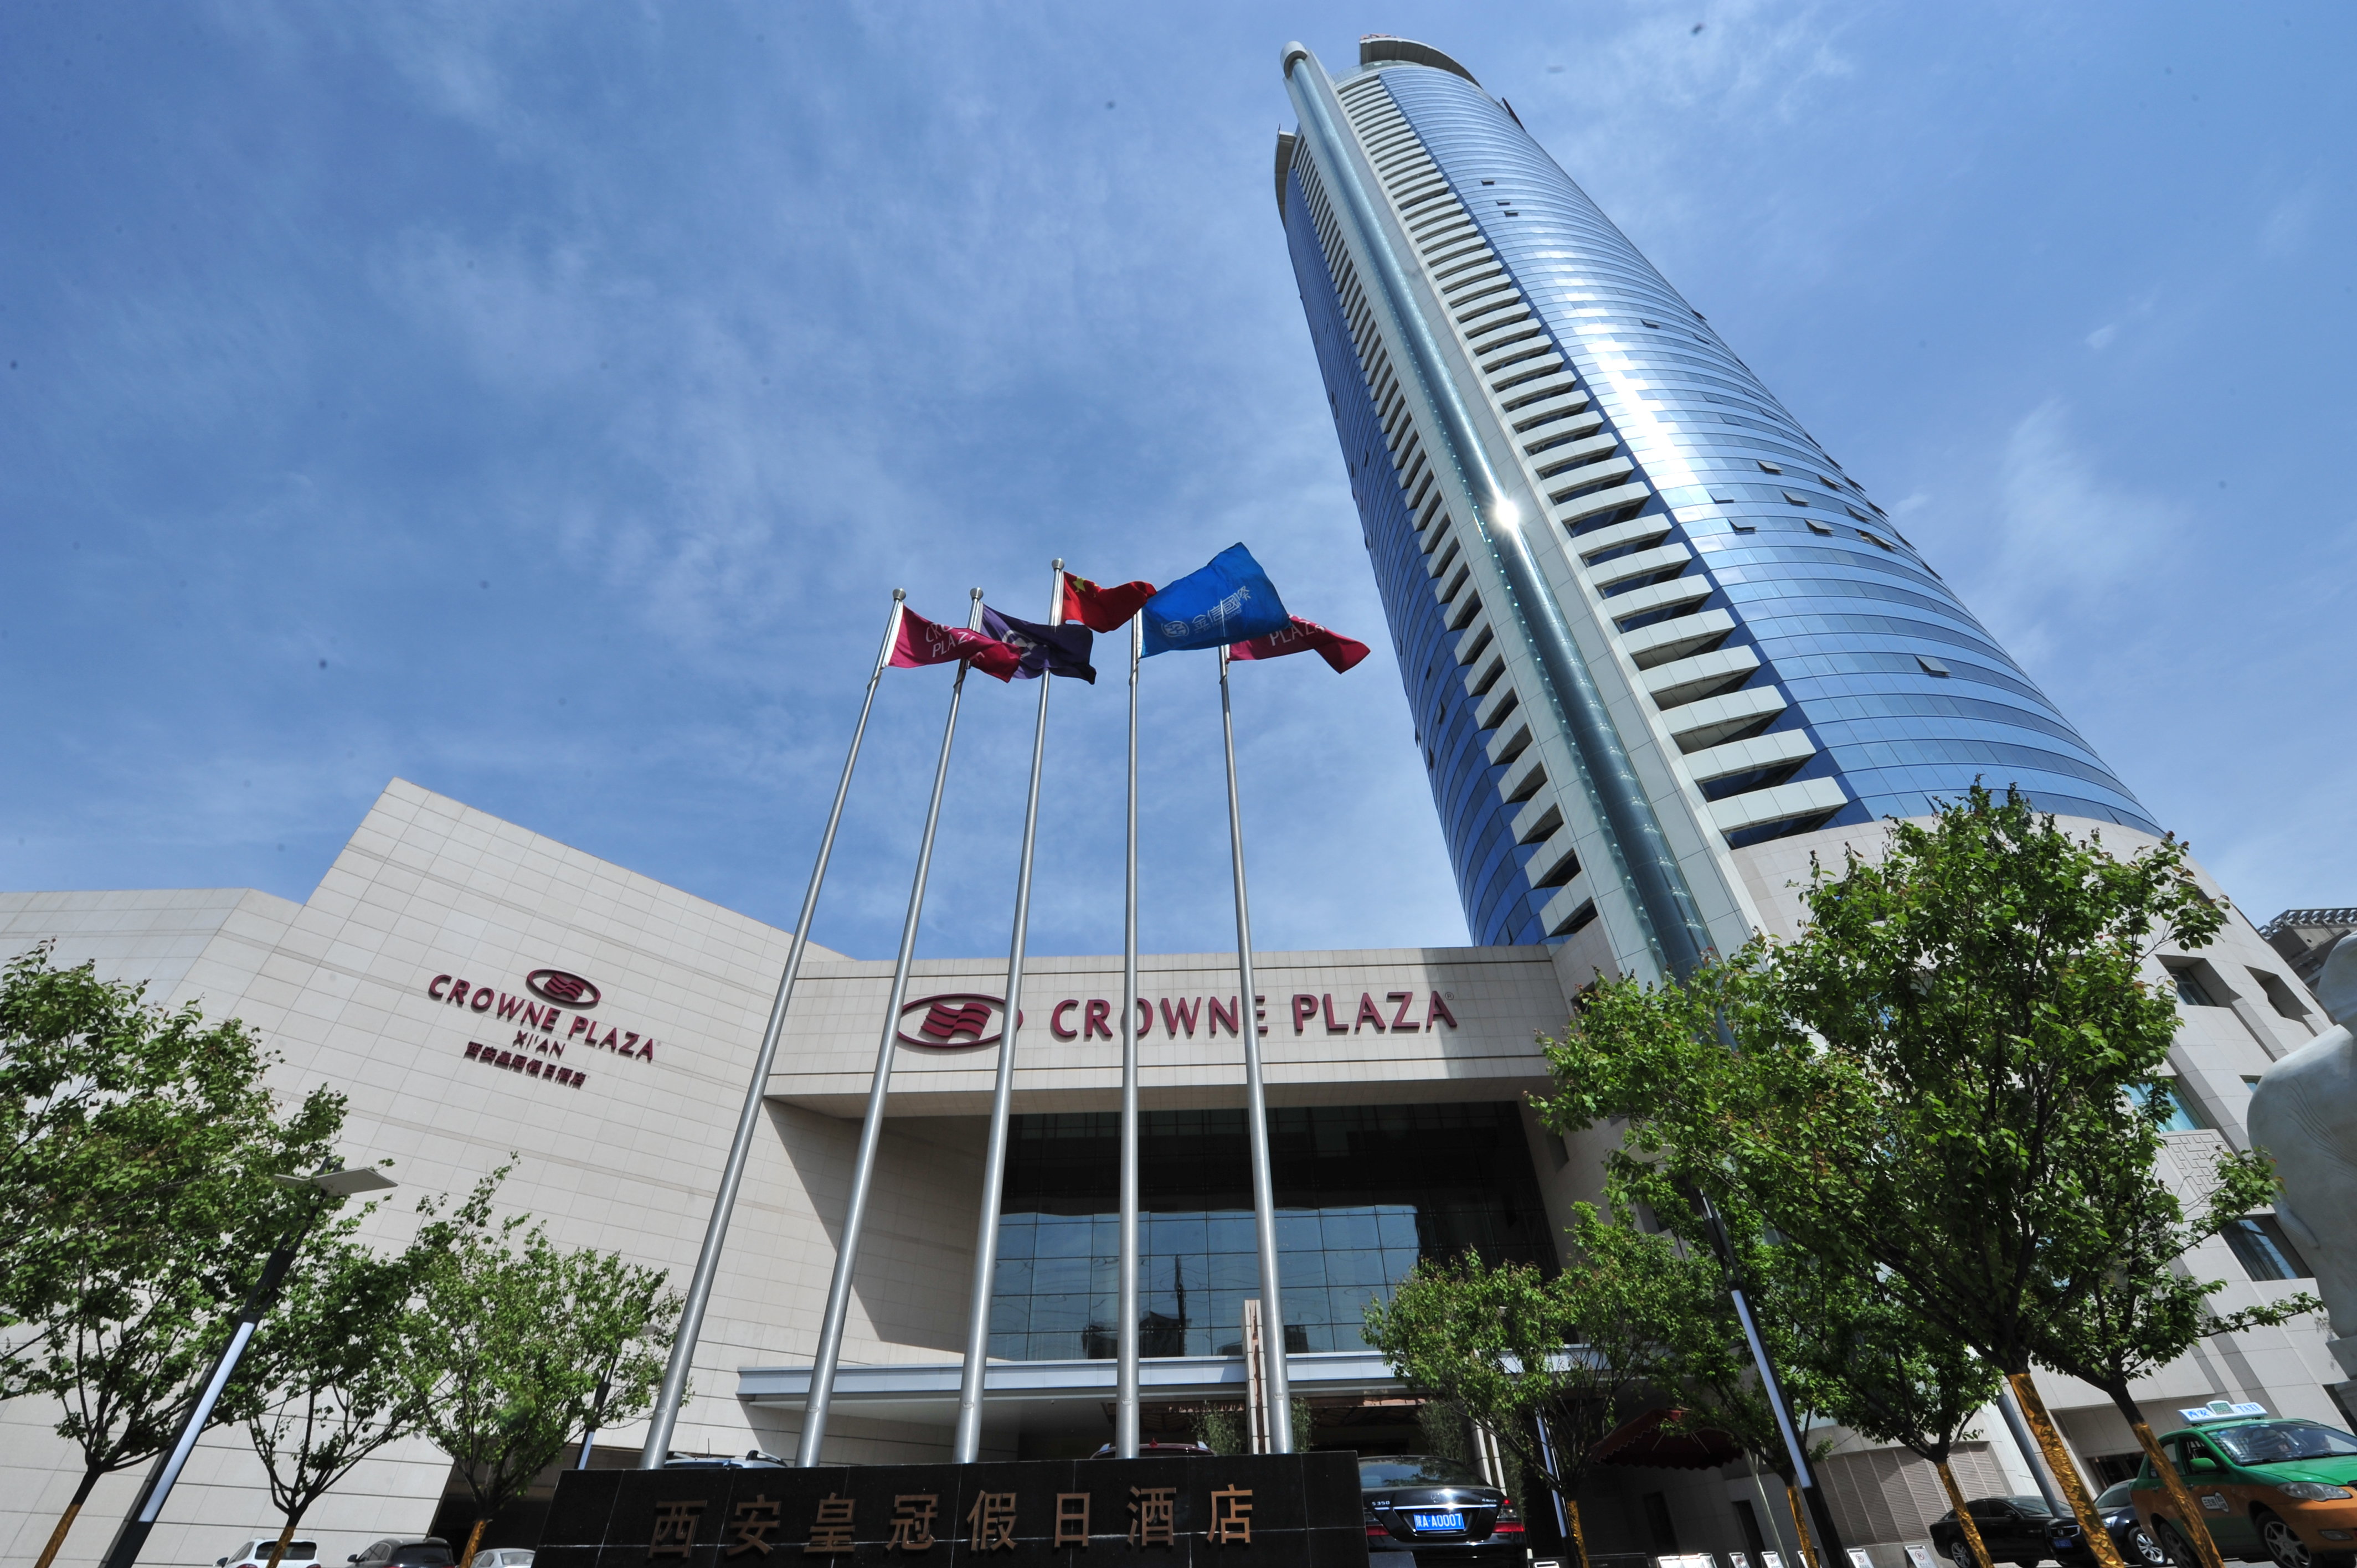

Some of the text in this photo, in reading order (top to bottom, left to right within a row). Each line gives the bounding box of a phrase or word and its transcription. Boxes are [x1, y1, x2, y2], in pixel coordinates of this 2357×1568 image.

[429, 974, 655, 1061] CROWNE PLAZA
[1051, 991, 1458, 1037] CROWNE PLAZA
[464, 1041, 587, 1090] 西安皇冠假日酒店
[512, 1030, 565, 1060] XI'AN
[2236, 1404, 2260, 1412] TAXI
[647, 1484, 1254, 1559] 西安皇冠假日酒店
